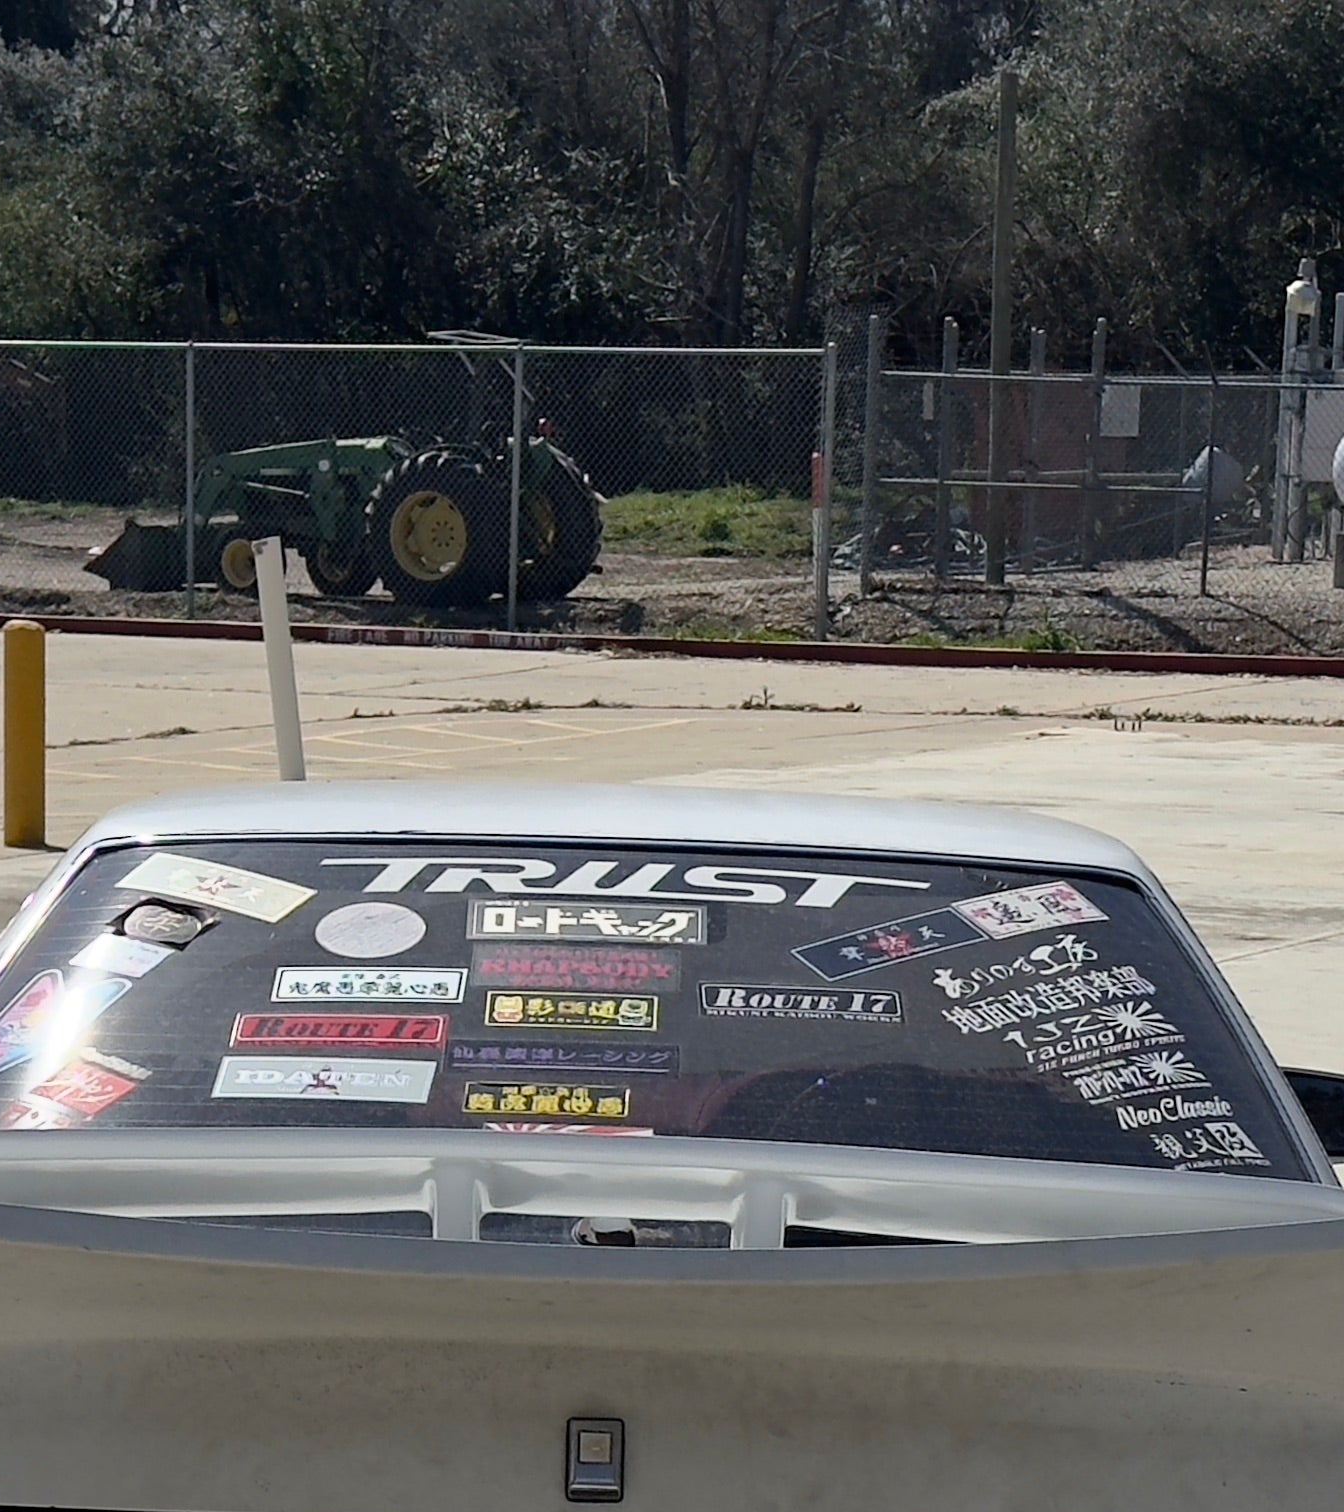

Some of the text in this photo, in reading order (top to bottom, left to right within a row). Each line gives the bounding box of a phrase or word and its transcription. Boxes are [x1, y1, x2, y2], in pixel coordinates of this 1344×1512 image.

[320, 857, 933, 908] TRUST
[846, 990, 895, 1012] 17
[389, 1018, 437, 1040] 17
[1025, 1027, 1116, 1064] racing
[1104, 1041, 1140, 1056] TURBO
[234, 1068, 414, 1089] IDATEN
